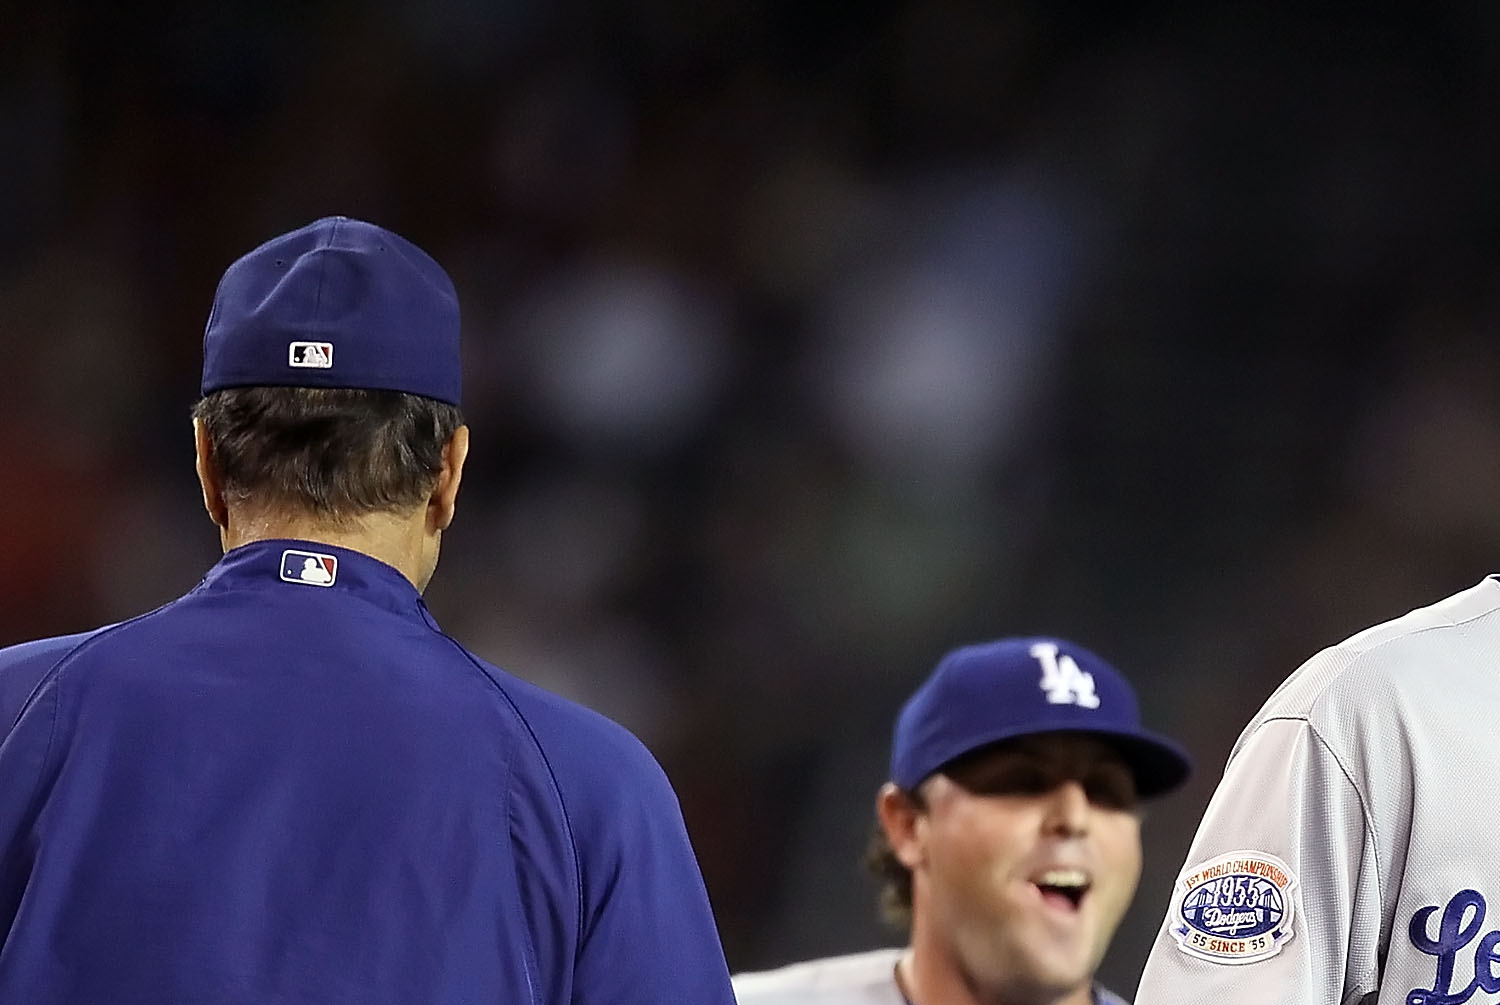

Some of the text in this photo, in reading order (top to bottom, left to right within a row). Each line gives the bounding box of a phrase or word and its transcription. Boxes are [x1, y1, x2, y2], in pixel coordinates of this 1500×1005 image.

[1029, 643, 1100, 709] LA
[1202, 862, 1231, 880] WORLD
[1212, 876, 1261, 908] 1955
[1204, 907, 1257, 936] Dodgers
[1210, 940, 1245, 952] SINCE
